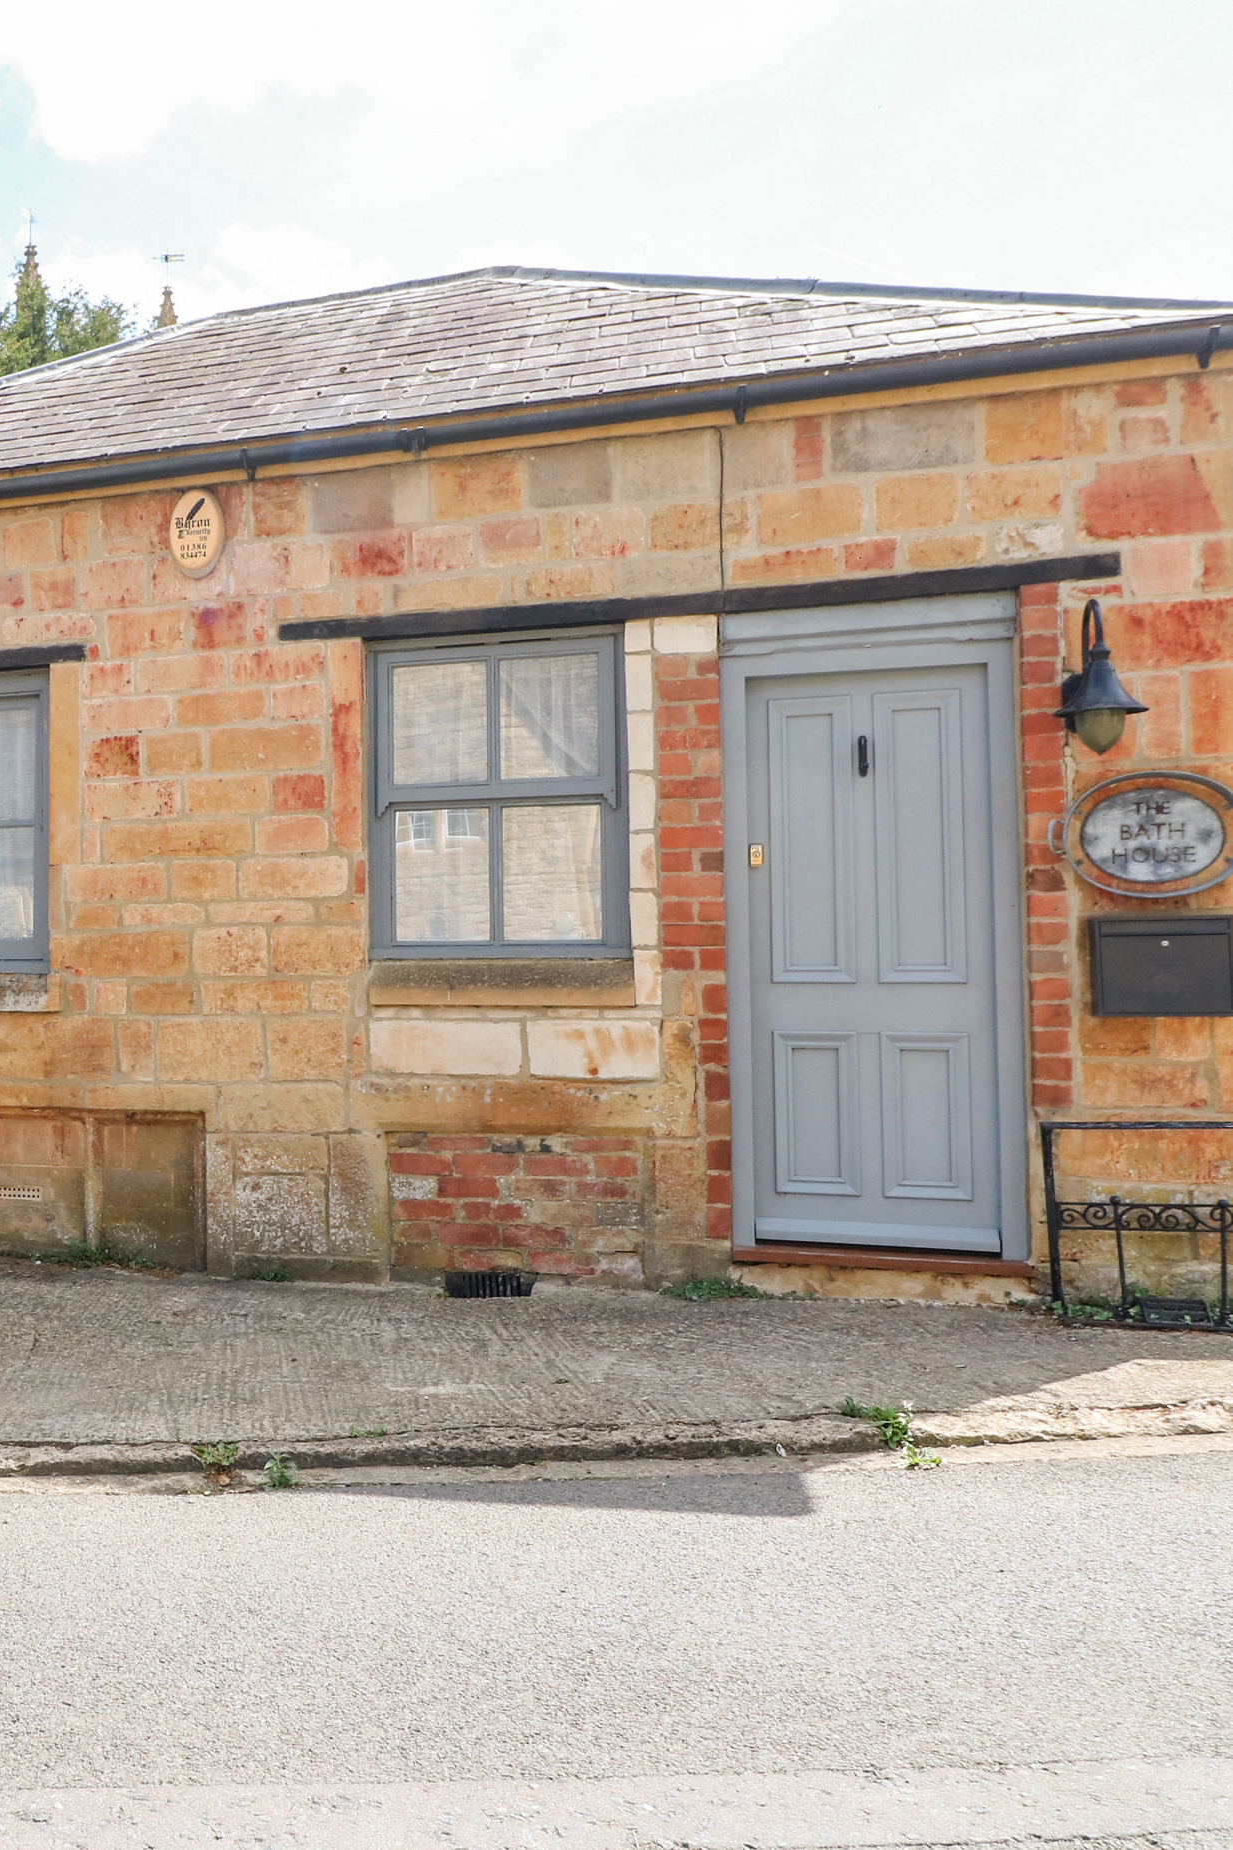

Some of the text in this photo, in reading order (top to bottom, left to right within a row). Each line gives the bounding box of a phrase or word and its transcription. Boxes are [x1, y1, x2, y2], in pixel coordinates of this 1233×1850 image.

[175, 517, 211, 530] Byron
[180, 543, 207, 551] 01386
[180, 551, 207, 559] 834474
[1132, 801, 1171, 815] THE
[1120, 822, 1185, 841] BATH
[1111, 846, 1196, 864] HOUSE
